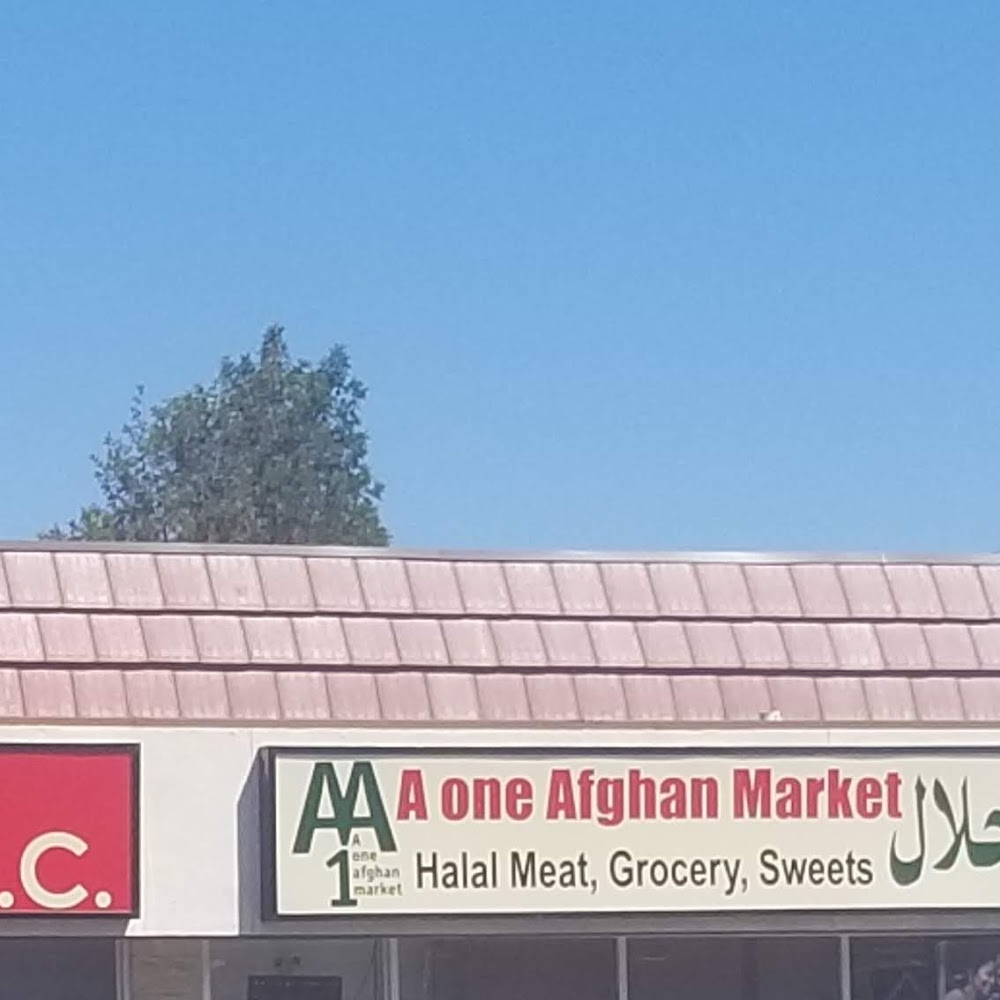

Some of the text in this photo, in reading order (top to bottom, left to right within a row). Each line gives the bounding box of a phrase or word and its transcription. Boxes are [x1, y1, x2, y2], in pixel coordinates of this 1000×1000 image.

[396, 768, 903, 828] A one Afghan Market
[351, 833, 362, 847] A
[352, 850, 377, 862] one
[325, 849, 358, 907] 1
[352, 864, 401, 883] afghan
[416, 848, 873, 896] Halal Meat, Grocery, Sweets
[353, 881, 403, 896] market
